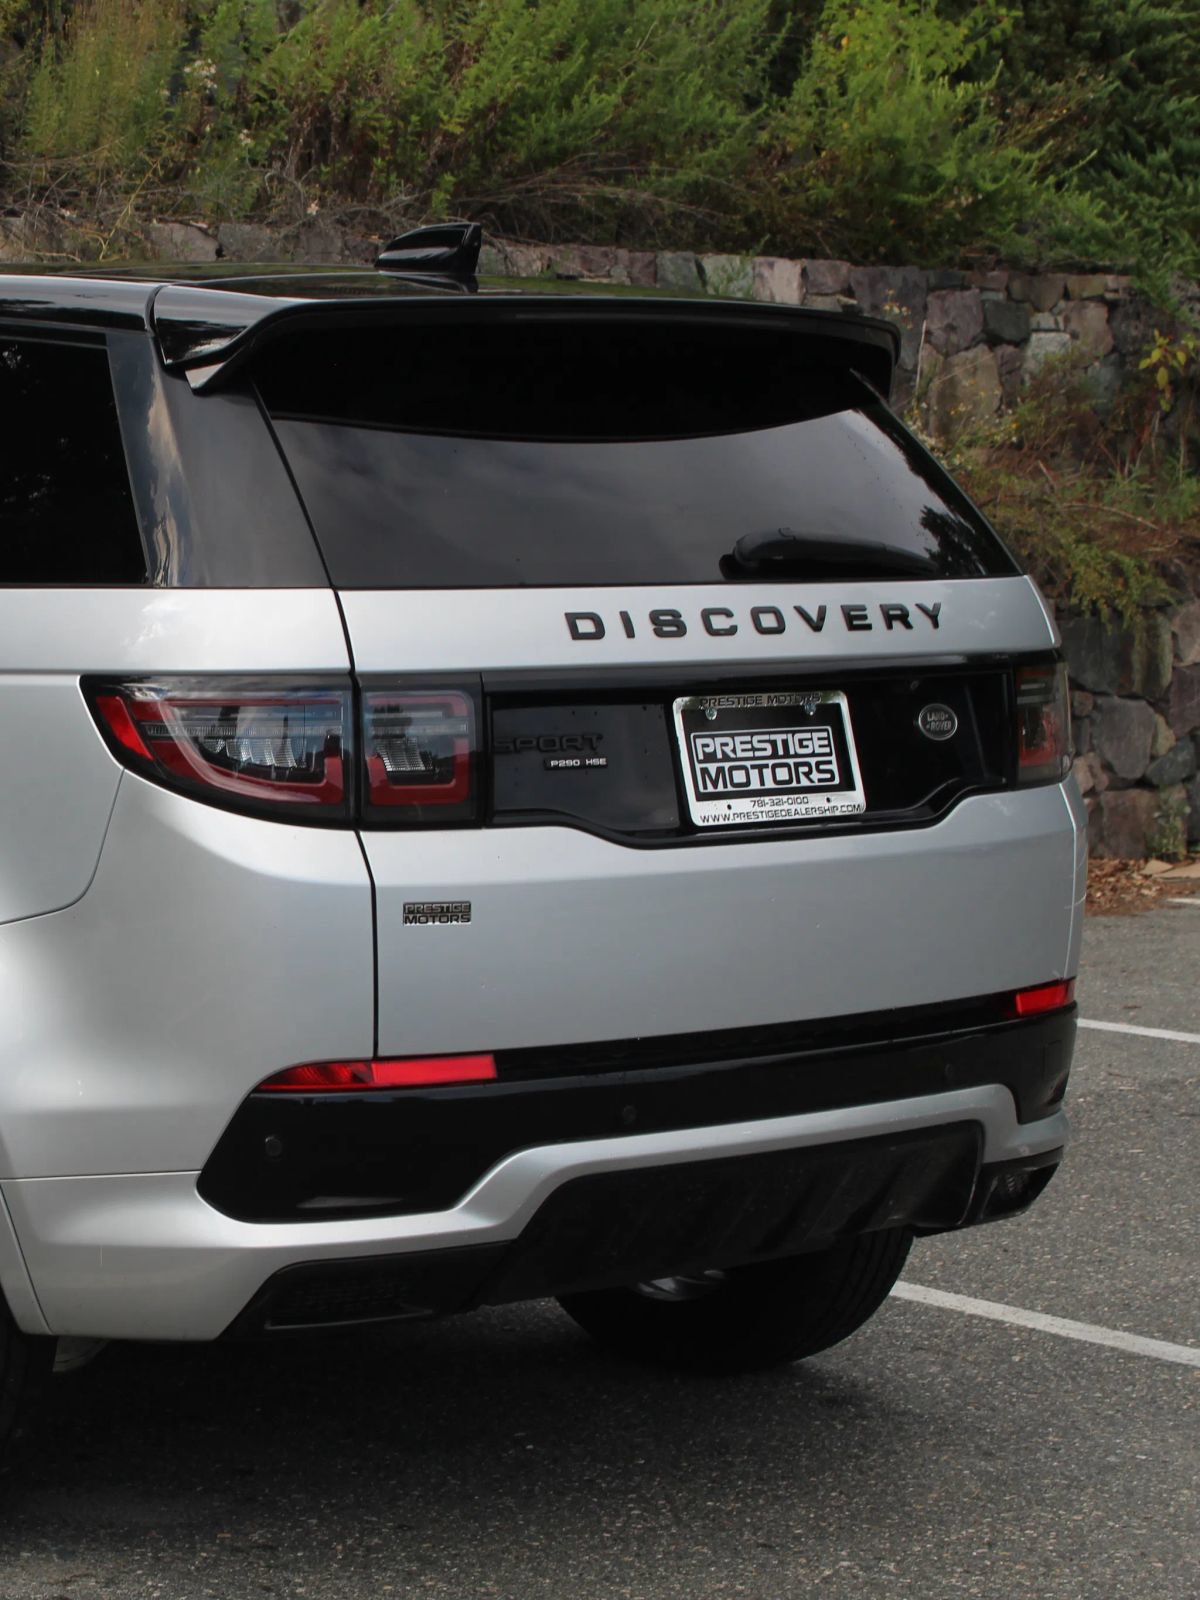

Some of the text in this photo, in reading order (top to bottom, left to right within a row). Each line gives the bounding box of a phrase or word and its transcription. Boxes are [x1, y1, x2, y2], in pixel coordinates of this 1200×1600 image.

[564, 602, 942, 641] DISCOVERY
[700, 695, 763, 708] PRESTIGE
[494, 734, 604, 754] SPORT
[695, 731, 830, 760] PRESTIGE
[550, 757, 607, 768] P290 HSE
[700, 760, 836, 790] MOTORS
[750, 796, 810, 808] 781-321-0100
[700, 804, 862, 823] WWW.PRESTIGEDEALERSHIP.COM
[405, 903, 470, 914] PRESTIGE
[404, 913, 471, 924] MOTORS
